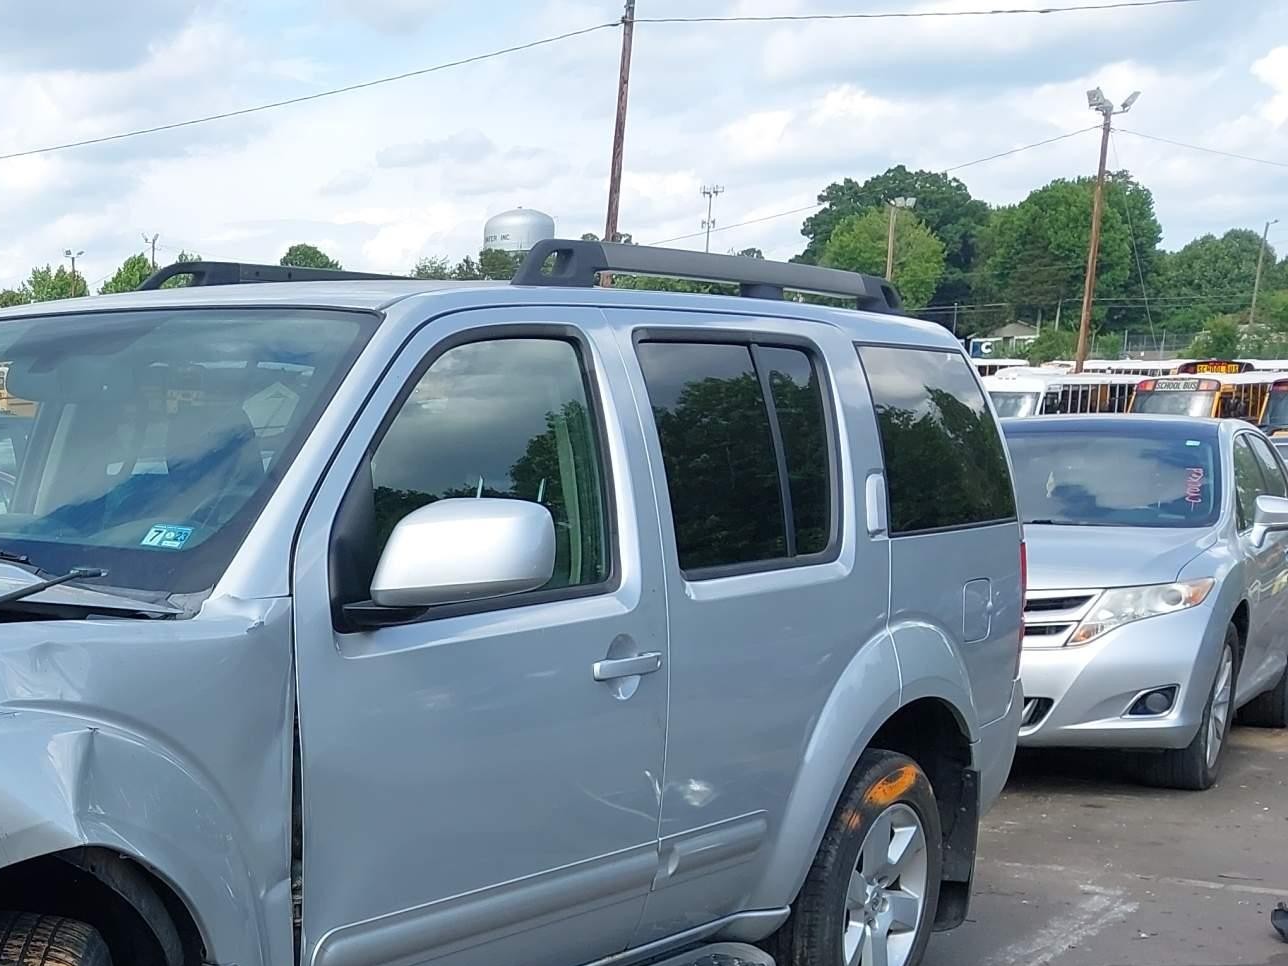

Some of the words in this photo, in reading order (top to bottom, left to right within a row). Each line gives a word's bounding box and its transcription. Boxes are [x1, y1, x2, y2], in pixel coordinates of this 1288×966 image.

[1156, 381, 1180, 390] SCHOOL
[1183, 381, 1197, 390] BUS
[149, 529, 163, 543] 7
[174, 531, 189, 542] 23
